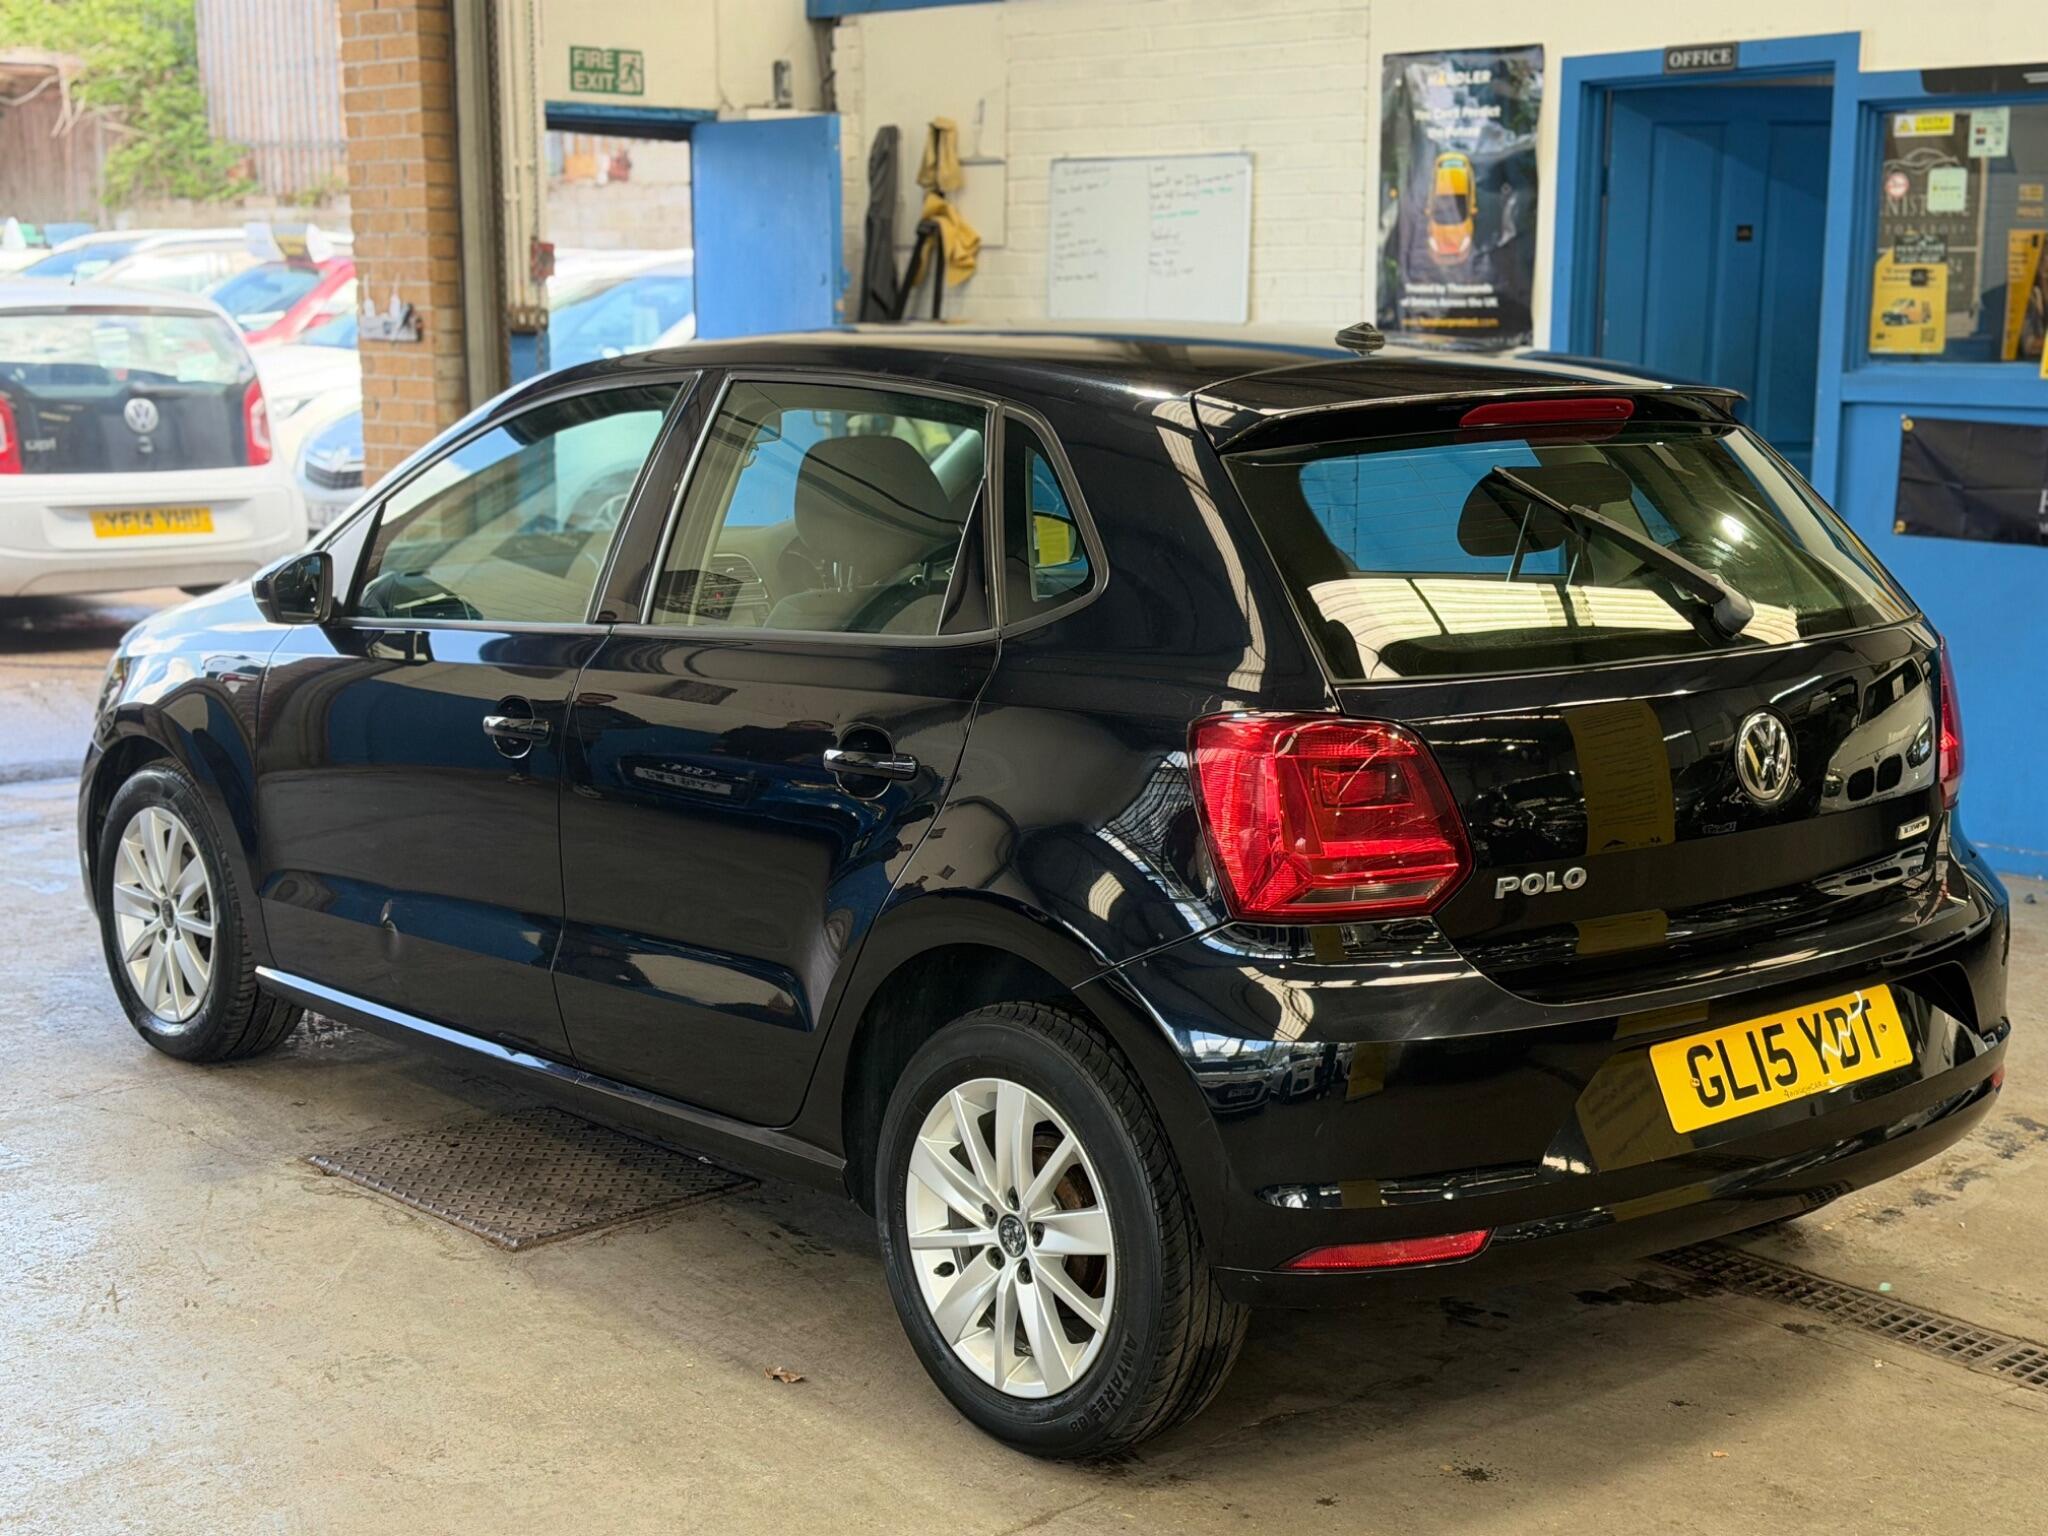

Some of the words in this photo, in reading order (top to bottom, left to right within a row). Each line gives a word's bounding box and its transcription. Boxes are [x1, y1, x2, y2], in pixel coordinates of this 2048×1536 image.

[573, 50, 614, 70] FIRE
[1669, 48, 1732, 68] OFFICE
[575, 70, 614, 91] EXIT
[1494, 866, 1588, 900] POLO
[1686, 1022, 1799, 1109] GL15
[1796, 998, 1882, 1076] YDT
